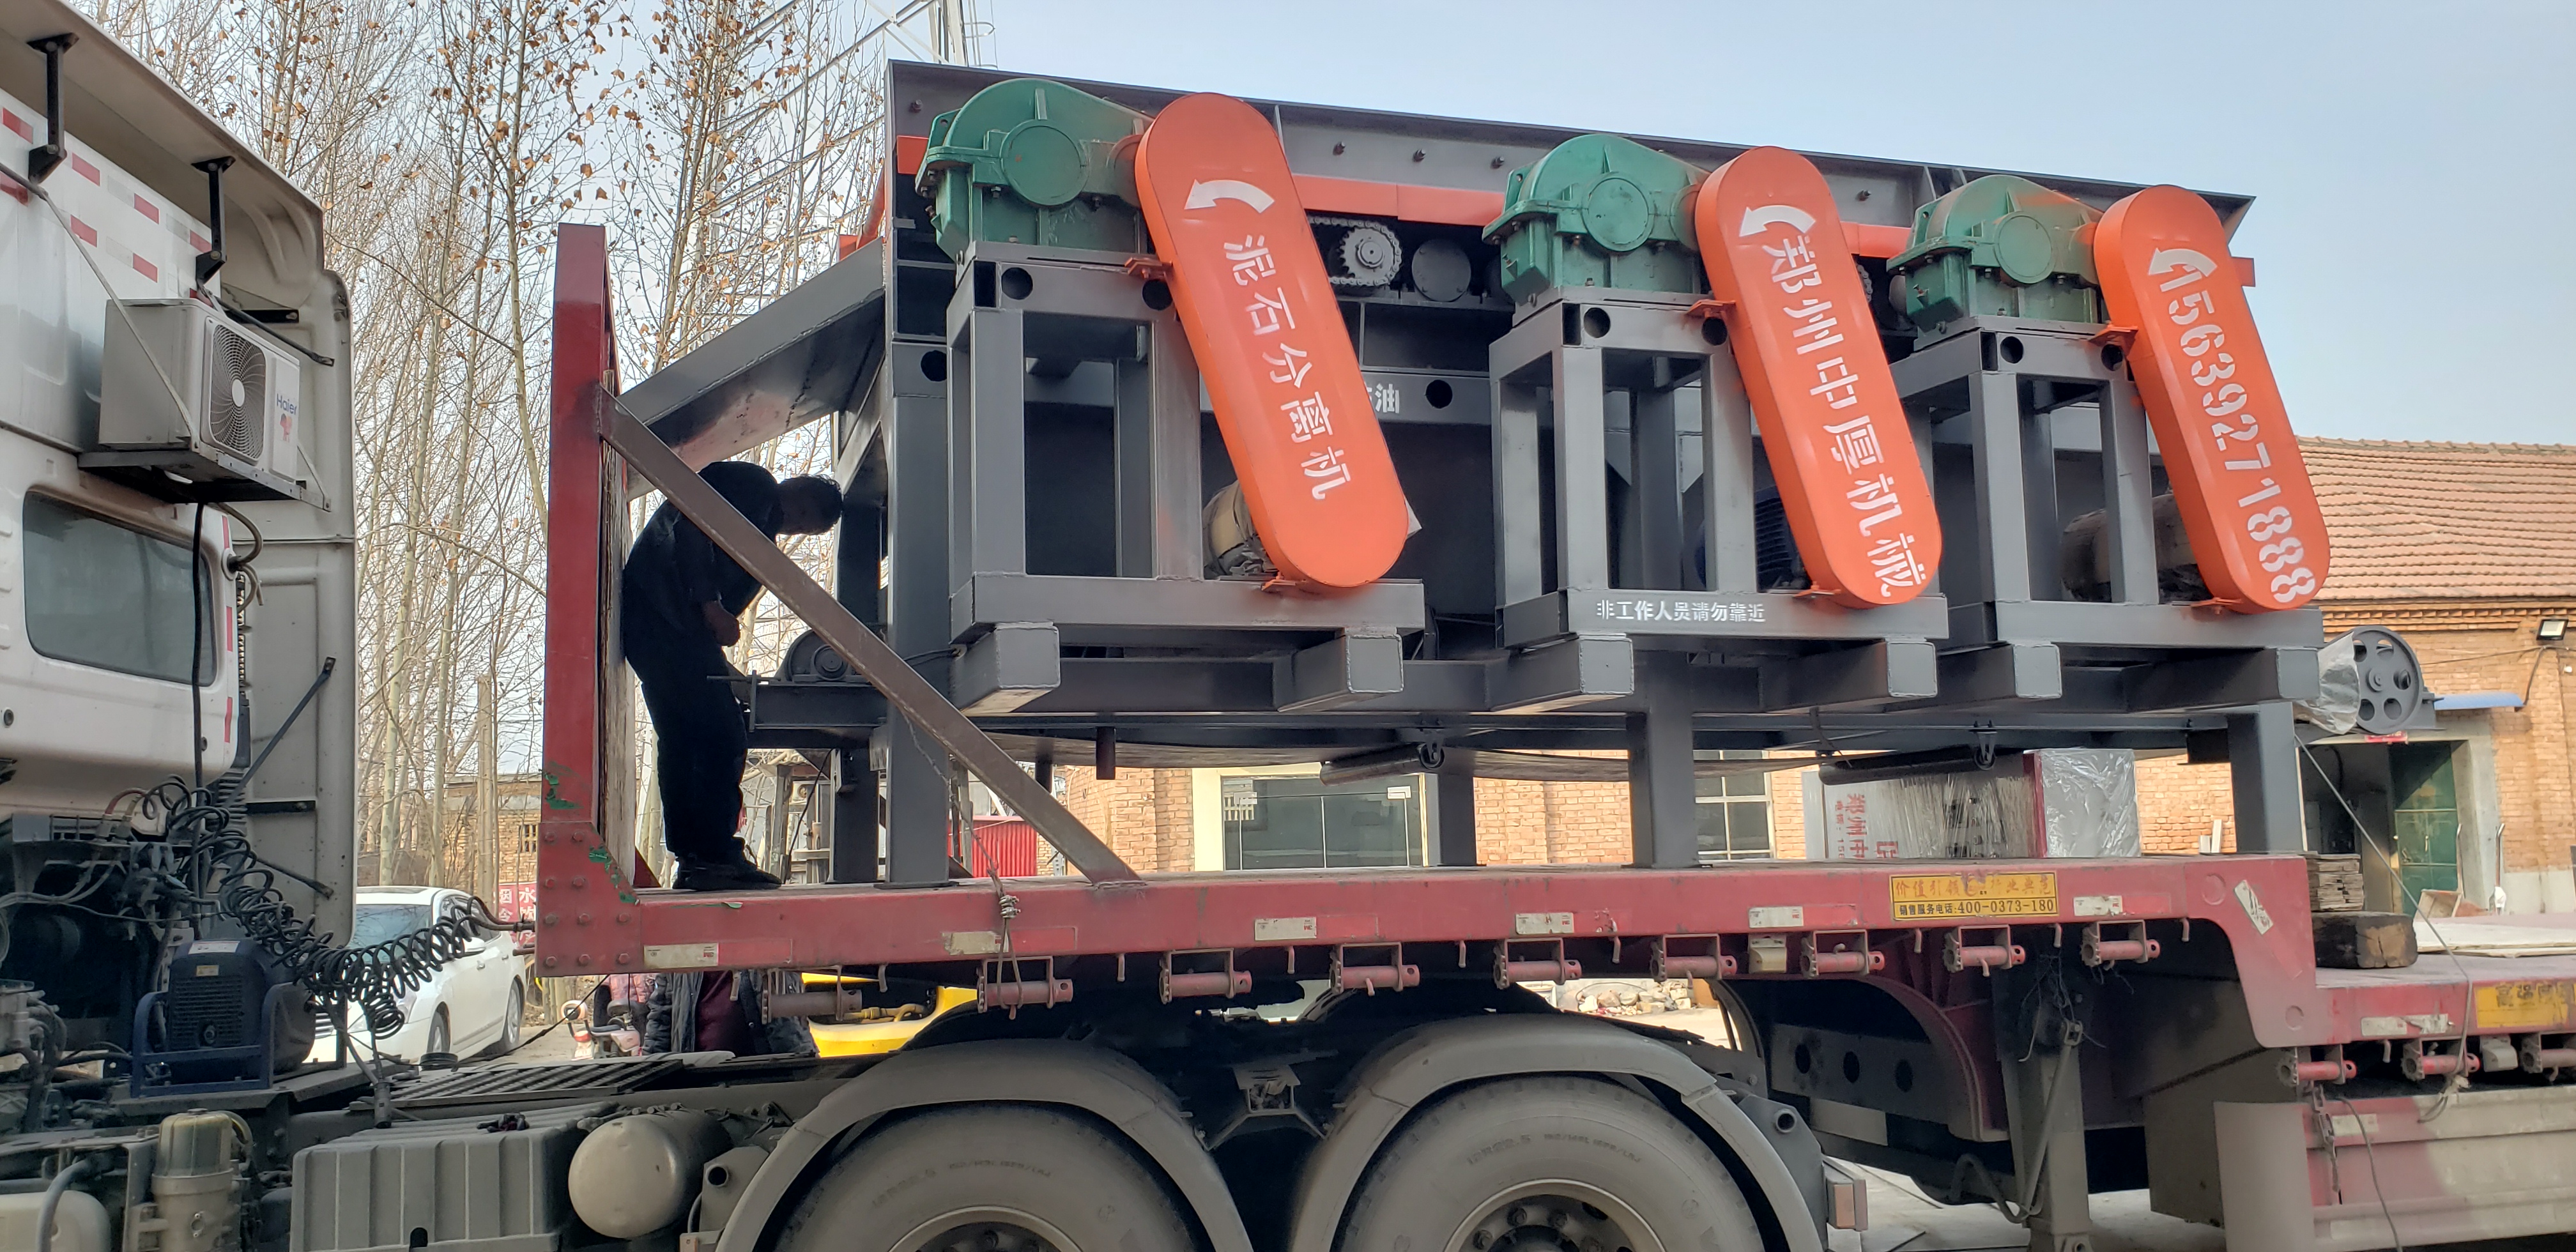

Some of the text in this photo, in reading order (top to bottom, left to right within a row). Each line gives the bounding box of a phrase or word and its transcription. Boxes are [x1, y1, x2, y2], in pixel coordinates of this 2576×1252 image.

[277, 393, 297, 415] Haier
[1223, 234, 1351, 500] 泥石分离机
[1366, 383, 1400, 414] 油
[1762, 234, 1926, 597] 郑州中厚机械
[2160, 264, 2316, 603] 15639271888
[1597, 599, 1767, 623] 非工作人员请勿靠近
